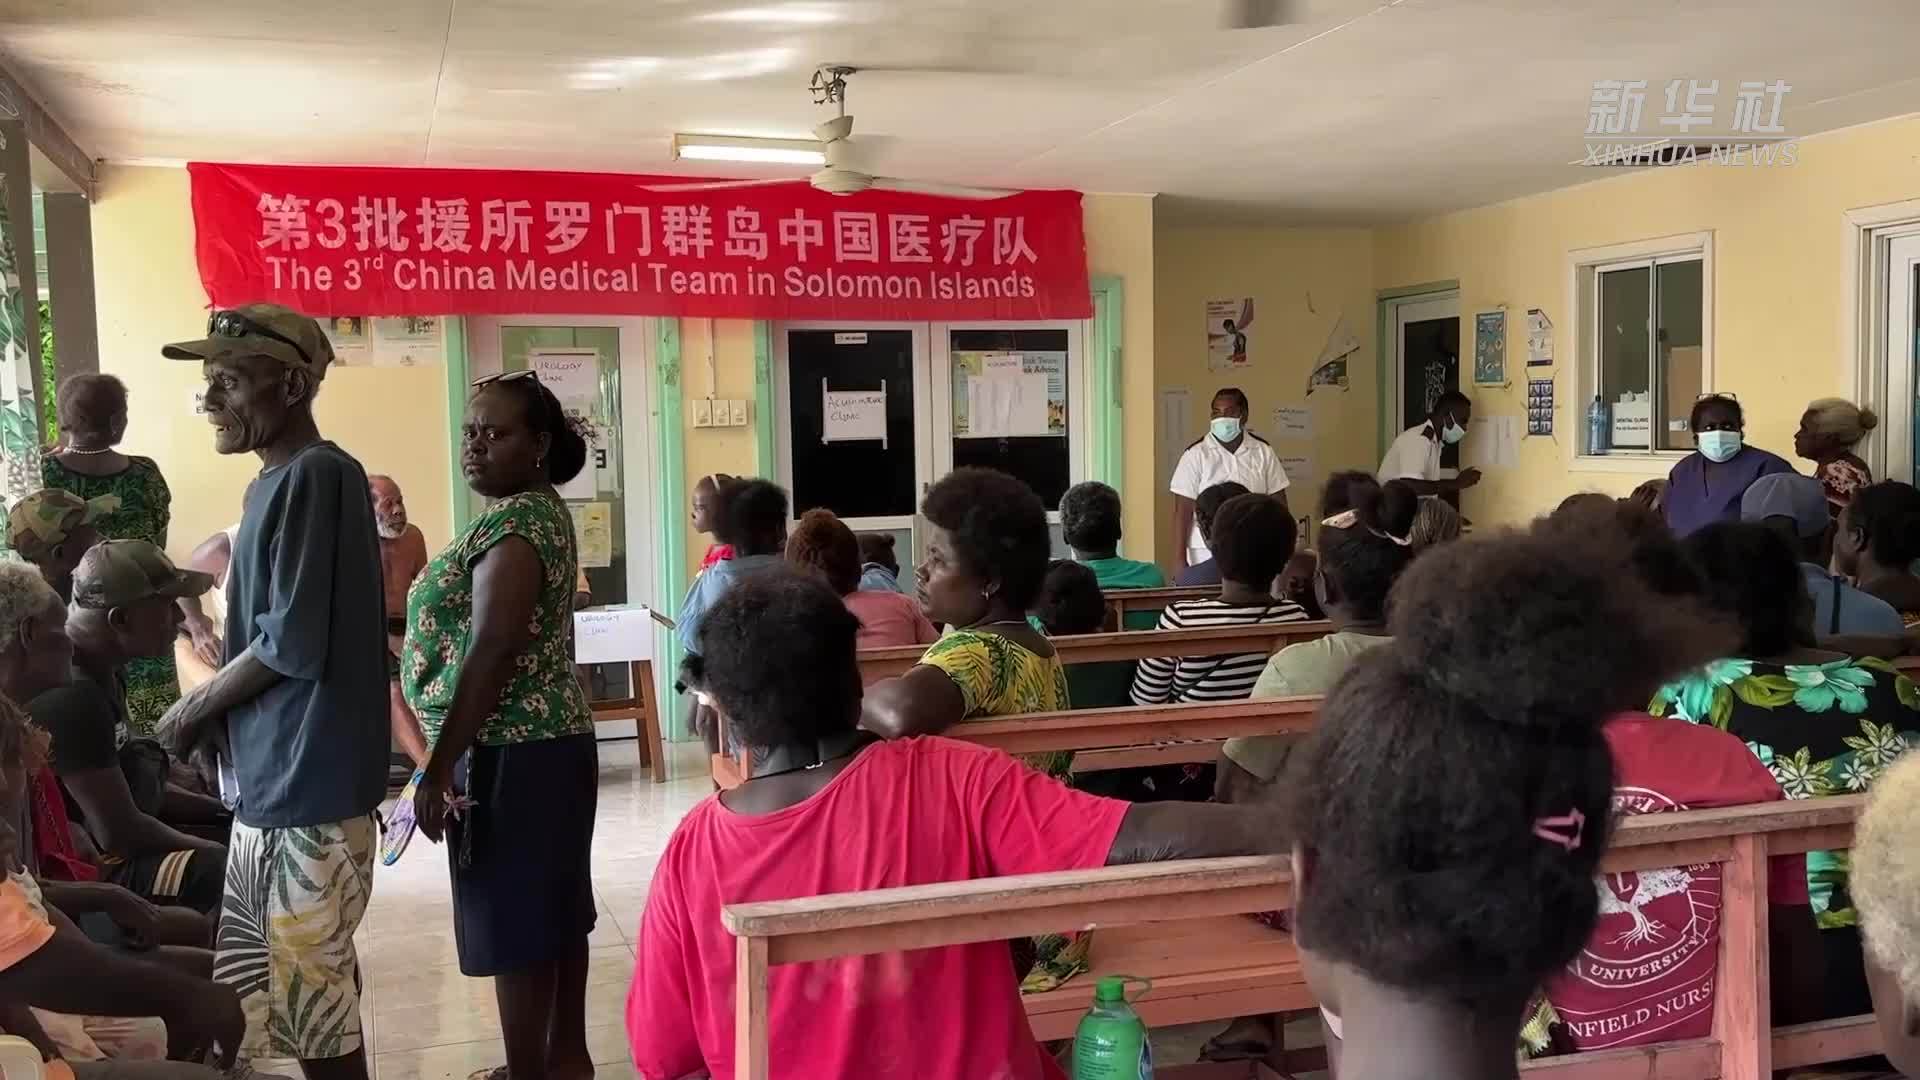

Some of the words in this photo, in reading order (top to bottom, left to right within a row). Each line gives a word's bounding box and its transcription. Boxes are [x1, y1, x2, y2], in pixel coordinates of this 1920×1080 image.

[256, 193, 1038, 267] 第3批援所罗门群岛中国医疗队
[265, 256, 333, 291] The
[343, 253, 384, 291] 3rd
[393, 258, 496, 291] China
[505, 260, 639, 292] Medical
[647, 262, 737, 295] Team
[747, 266, 776, 297] in
[784, 266, 922, 298] Solomon
[930, 270, 1035, 300] Islands
[1590, 934, 1699, 980] UNIVERSITY
[1568, 1007, 1651, 1038] NFIELD
